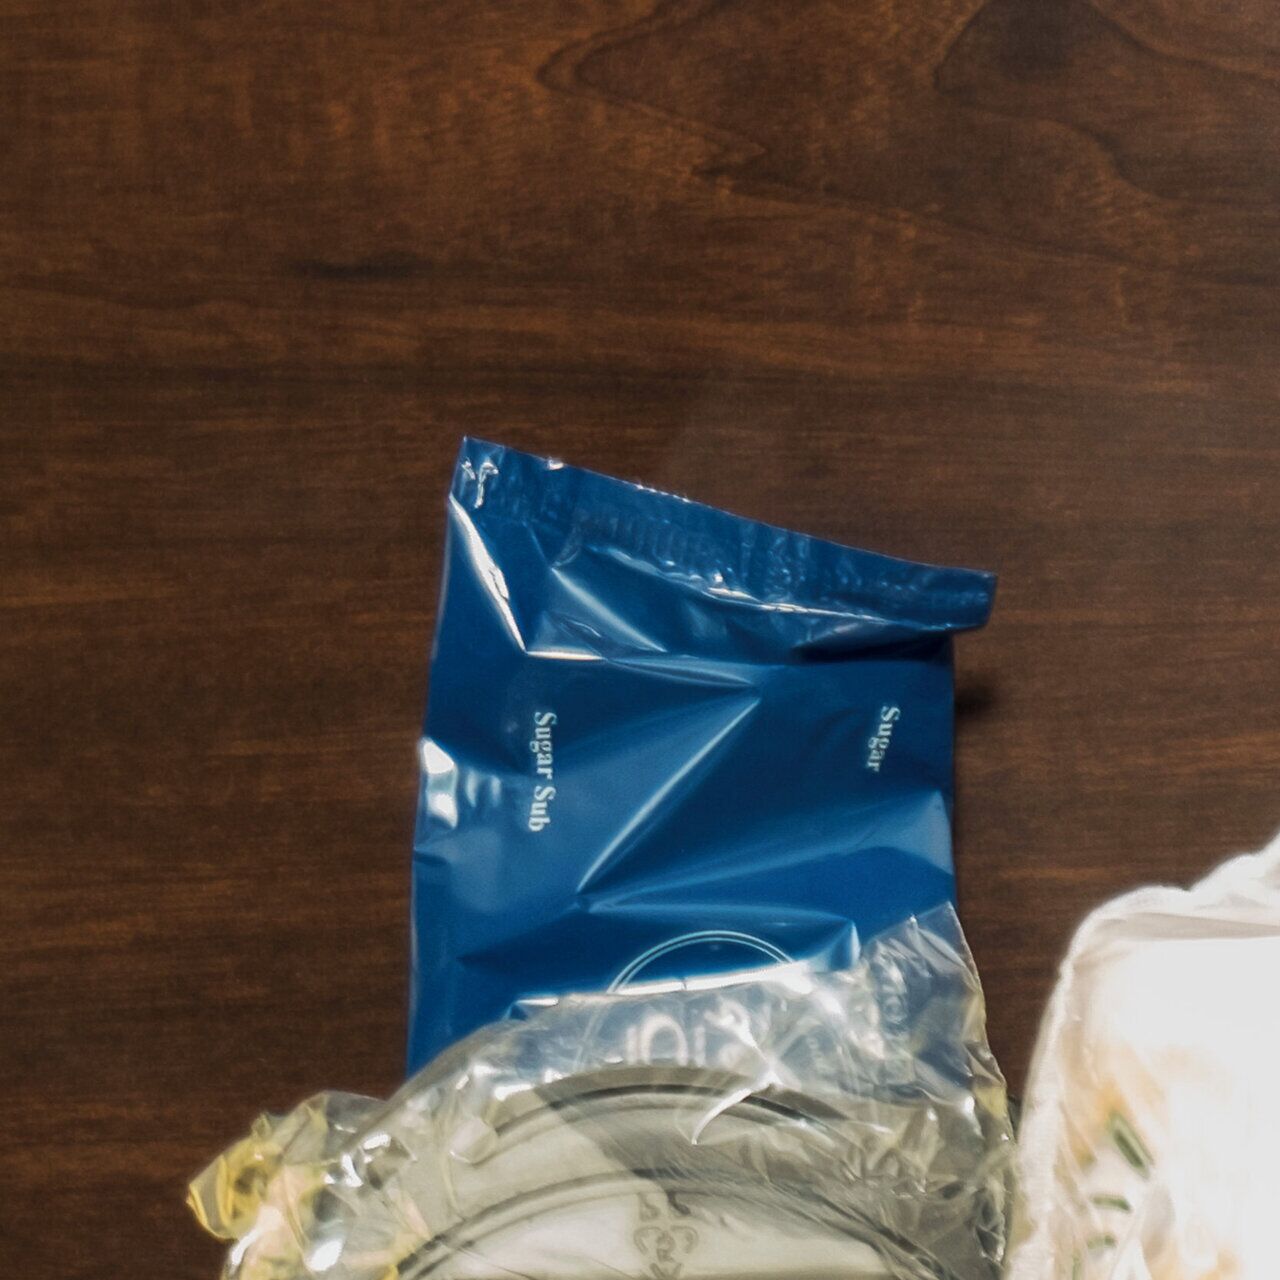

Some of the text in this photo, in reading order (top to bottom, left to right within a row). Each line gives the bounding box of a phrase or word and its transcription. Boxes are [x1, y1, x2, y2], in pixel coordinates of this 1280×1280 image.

[528, 711, 557, 832] Sugar Sub
[867, 706, 901, 773] Sugar
